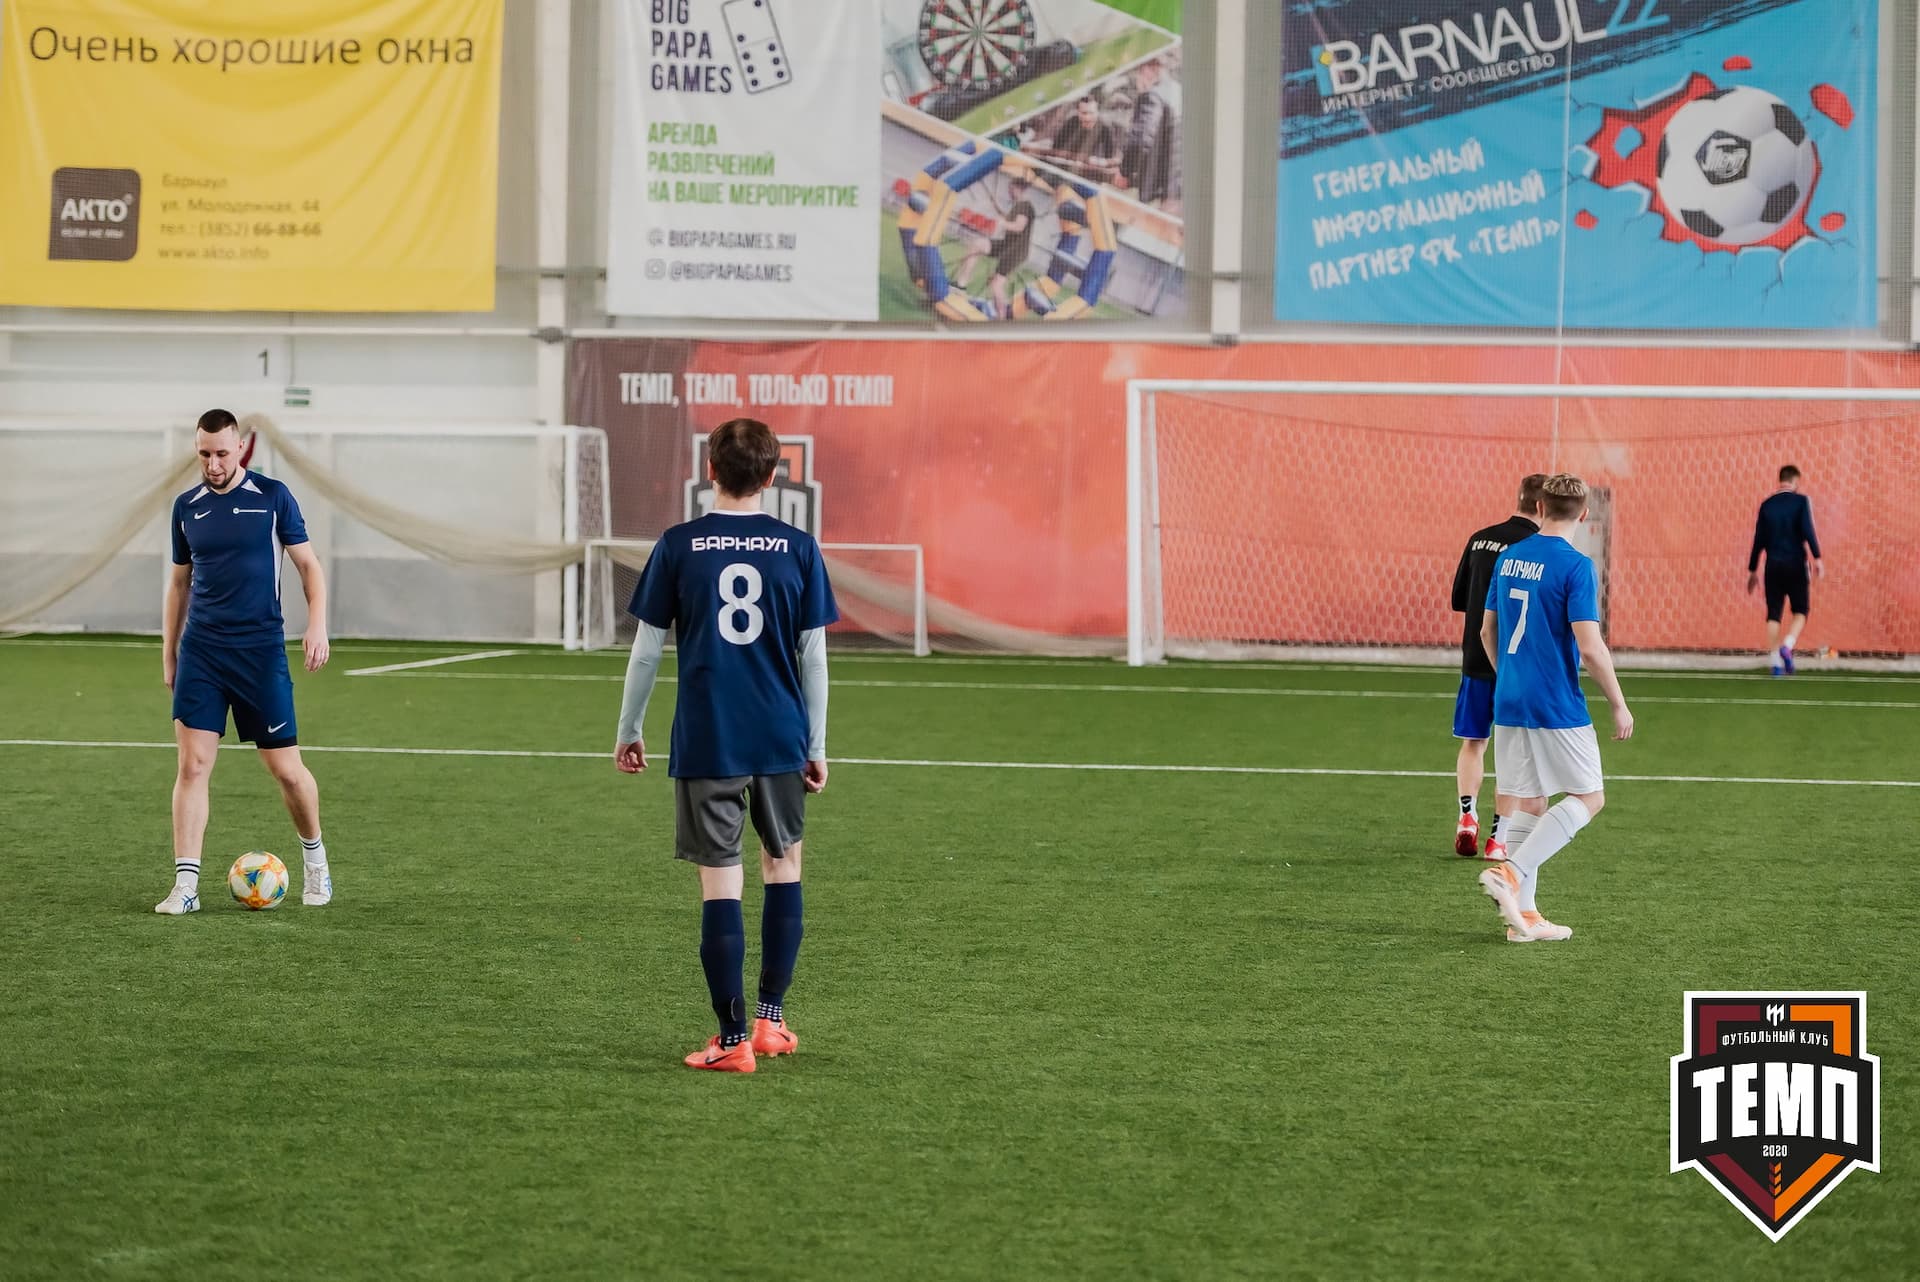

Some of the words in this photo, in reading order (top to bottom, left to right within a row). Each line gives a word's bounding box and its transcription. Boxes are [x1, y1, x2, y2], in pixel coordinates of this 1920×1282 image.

[652, 0, 688, 24] BIG
[30, 26, 158, 63] Очень
[172, 35, 361, 71] хорошие
[377, 35, 475, 64] окна
[652, 30, 711, 58] PAPA
[652, 64, 732, 93] GAMES
[1322, 82, 1414, 114] ИНТЕРНЕТ
[1431, 53, 1556, 92] СООБЩЕСТВО
[648, 122, 718, 146] АРЕНДА
[648, 151, 775, 177] РАЗВЛЕЧЕНИЙ
[1312, 136, 1485, 201] ГЕНЕРАЛЬНЫЙ
[648, 181, 670, 203] НА
[675, 181, 724, 204] ВАШЕ
[729, 183, 859, 208] МЕРОПРИЯТИЕ
[1312, 168, 1546, 248] ИНФОРМАЦИОННЫЙ
[669, 230, 797, 249] BIGPAPAGAMES.RU
[1309, 244, 1415, 291] ПАРТНЕР
[1420, 234, 1463, 267] ФК
[1468, 216, 1561, 256] «ТЕМП»
[258, 349, 269, 377] 1
[619, 372, 680, 408] ТЕМП,
[684, 373, 744, 409] ТЕМП,
[748, 373, 829, 407] ТОЛЬКО
[832, 374, 894, 408] ТЕМП!
[691, 535, 789, 553] БАРНАУЛ
[1500, 558, 1545, 582] ВОЛЧИХА
[717, 562, 764, 646] 8
[1507, 587, 1530, 655] 7
